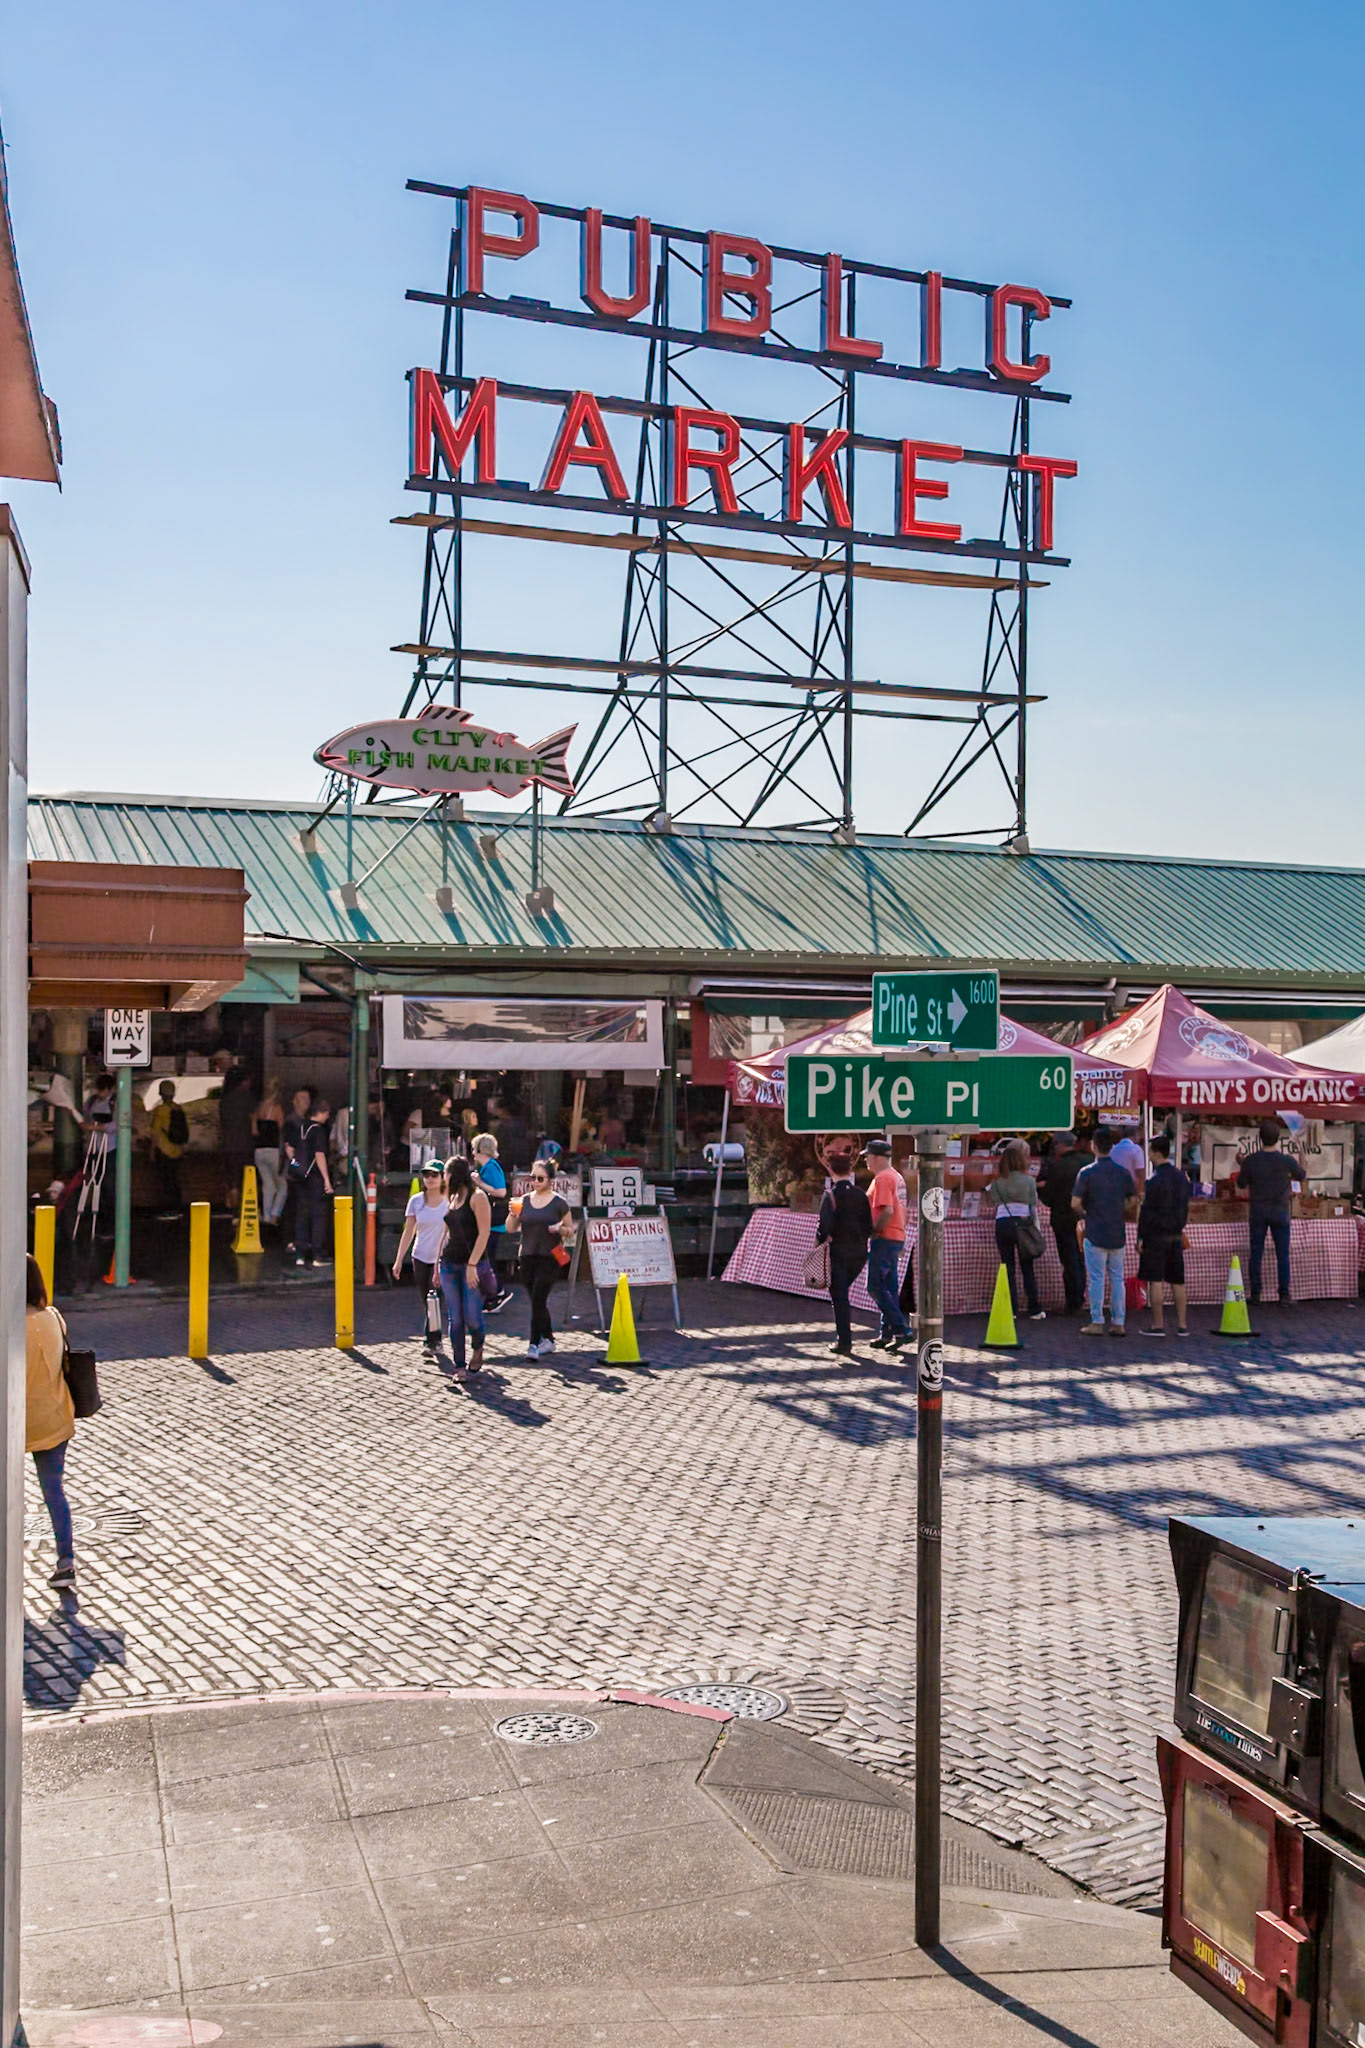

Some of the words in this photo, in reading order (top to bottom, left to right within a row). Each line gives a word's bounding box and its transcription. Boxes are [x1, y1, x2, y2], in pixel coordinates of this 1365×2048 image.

[462, 186, 1051, 383] PUBLIC
[409, 367, 1078, 552] MARKET
[412, 728, 488, 748] CITY
[348, 749, 414, 767] FISH
[428, 753, 546, 775] MARKET
[111, 1009, 144, 1023] ONE
[878, 982, 918, 1035] Pine
[970, 980, 995, 1004] 1600
[111, 1027, 145, 1040] WAY
[808, 1063, 914, 1118] Pike
[946, 1081, 979, 1117] Pl
[1039, 1066, 1066, 1090] 60
[1177, 1078, 1247, 1104] TINY'S
[1253, 1078, 1355, 1103] ORGANIC
[592, 1223, 610, 1240] NO
[615, 1221, 664, 1236] PARKING
[594, 1245, 612, 1253] FROM
